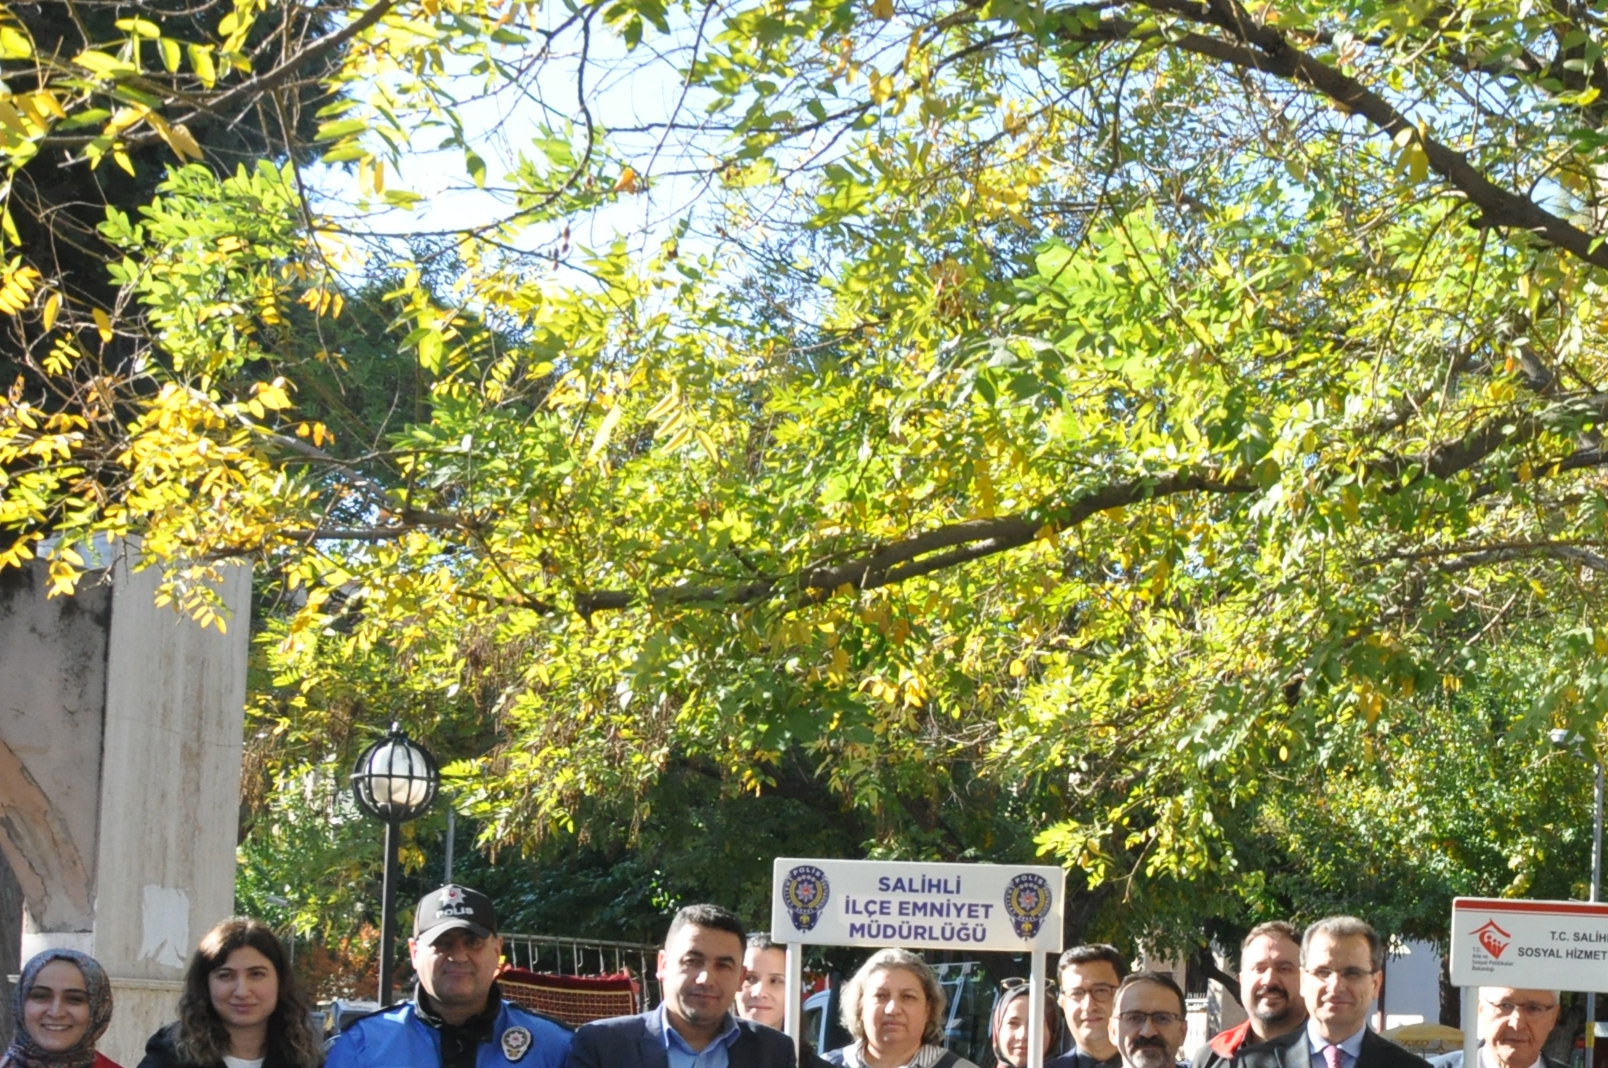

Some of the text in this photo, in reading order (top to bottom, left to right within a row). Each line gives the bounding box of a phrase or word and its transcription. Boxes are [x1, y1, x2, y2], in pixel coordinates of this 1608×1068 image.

[878, 874, 961, 894] SALİHLİ
[845, 895, 993, 920] İLÇE EMNİYET
[849, 920, 987, 942] MÜDÜRLÜĞÜ
[1550, 931, 1569, 942] T.C.
[1518, 946, 1563, 959] SOSYAL
[1566, 947, 1608, 961] HİZMET
